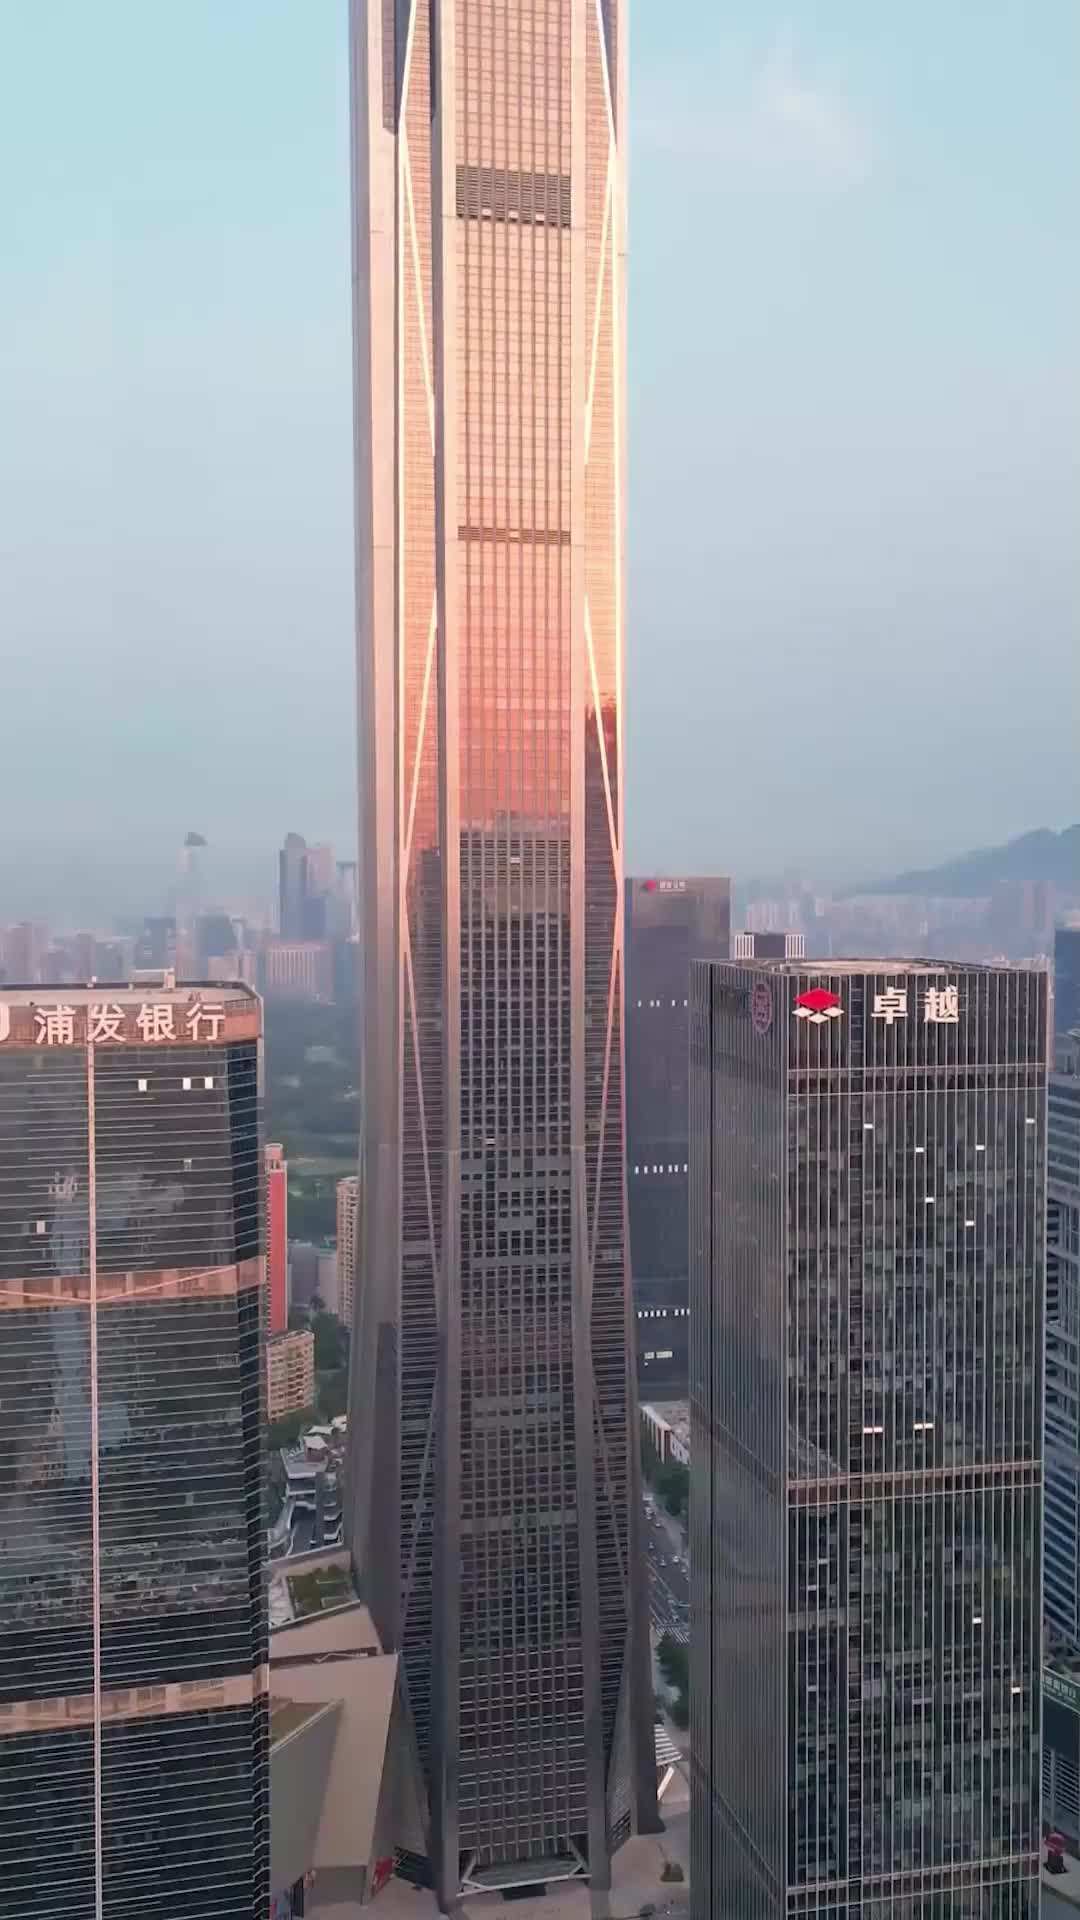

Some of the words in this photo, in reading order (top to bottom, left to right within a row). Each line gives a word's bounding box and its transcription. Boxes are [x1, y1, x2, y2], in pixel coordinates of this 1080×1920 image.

[33, 1003, 226, 1045] 浦发银行
[871, 984, 960, 1024] 卓越
